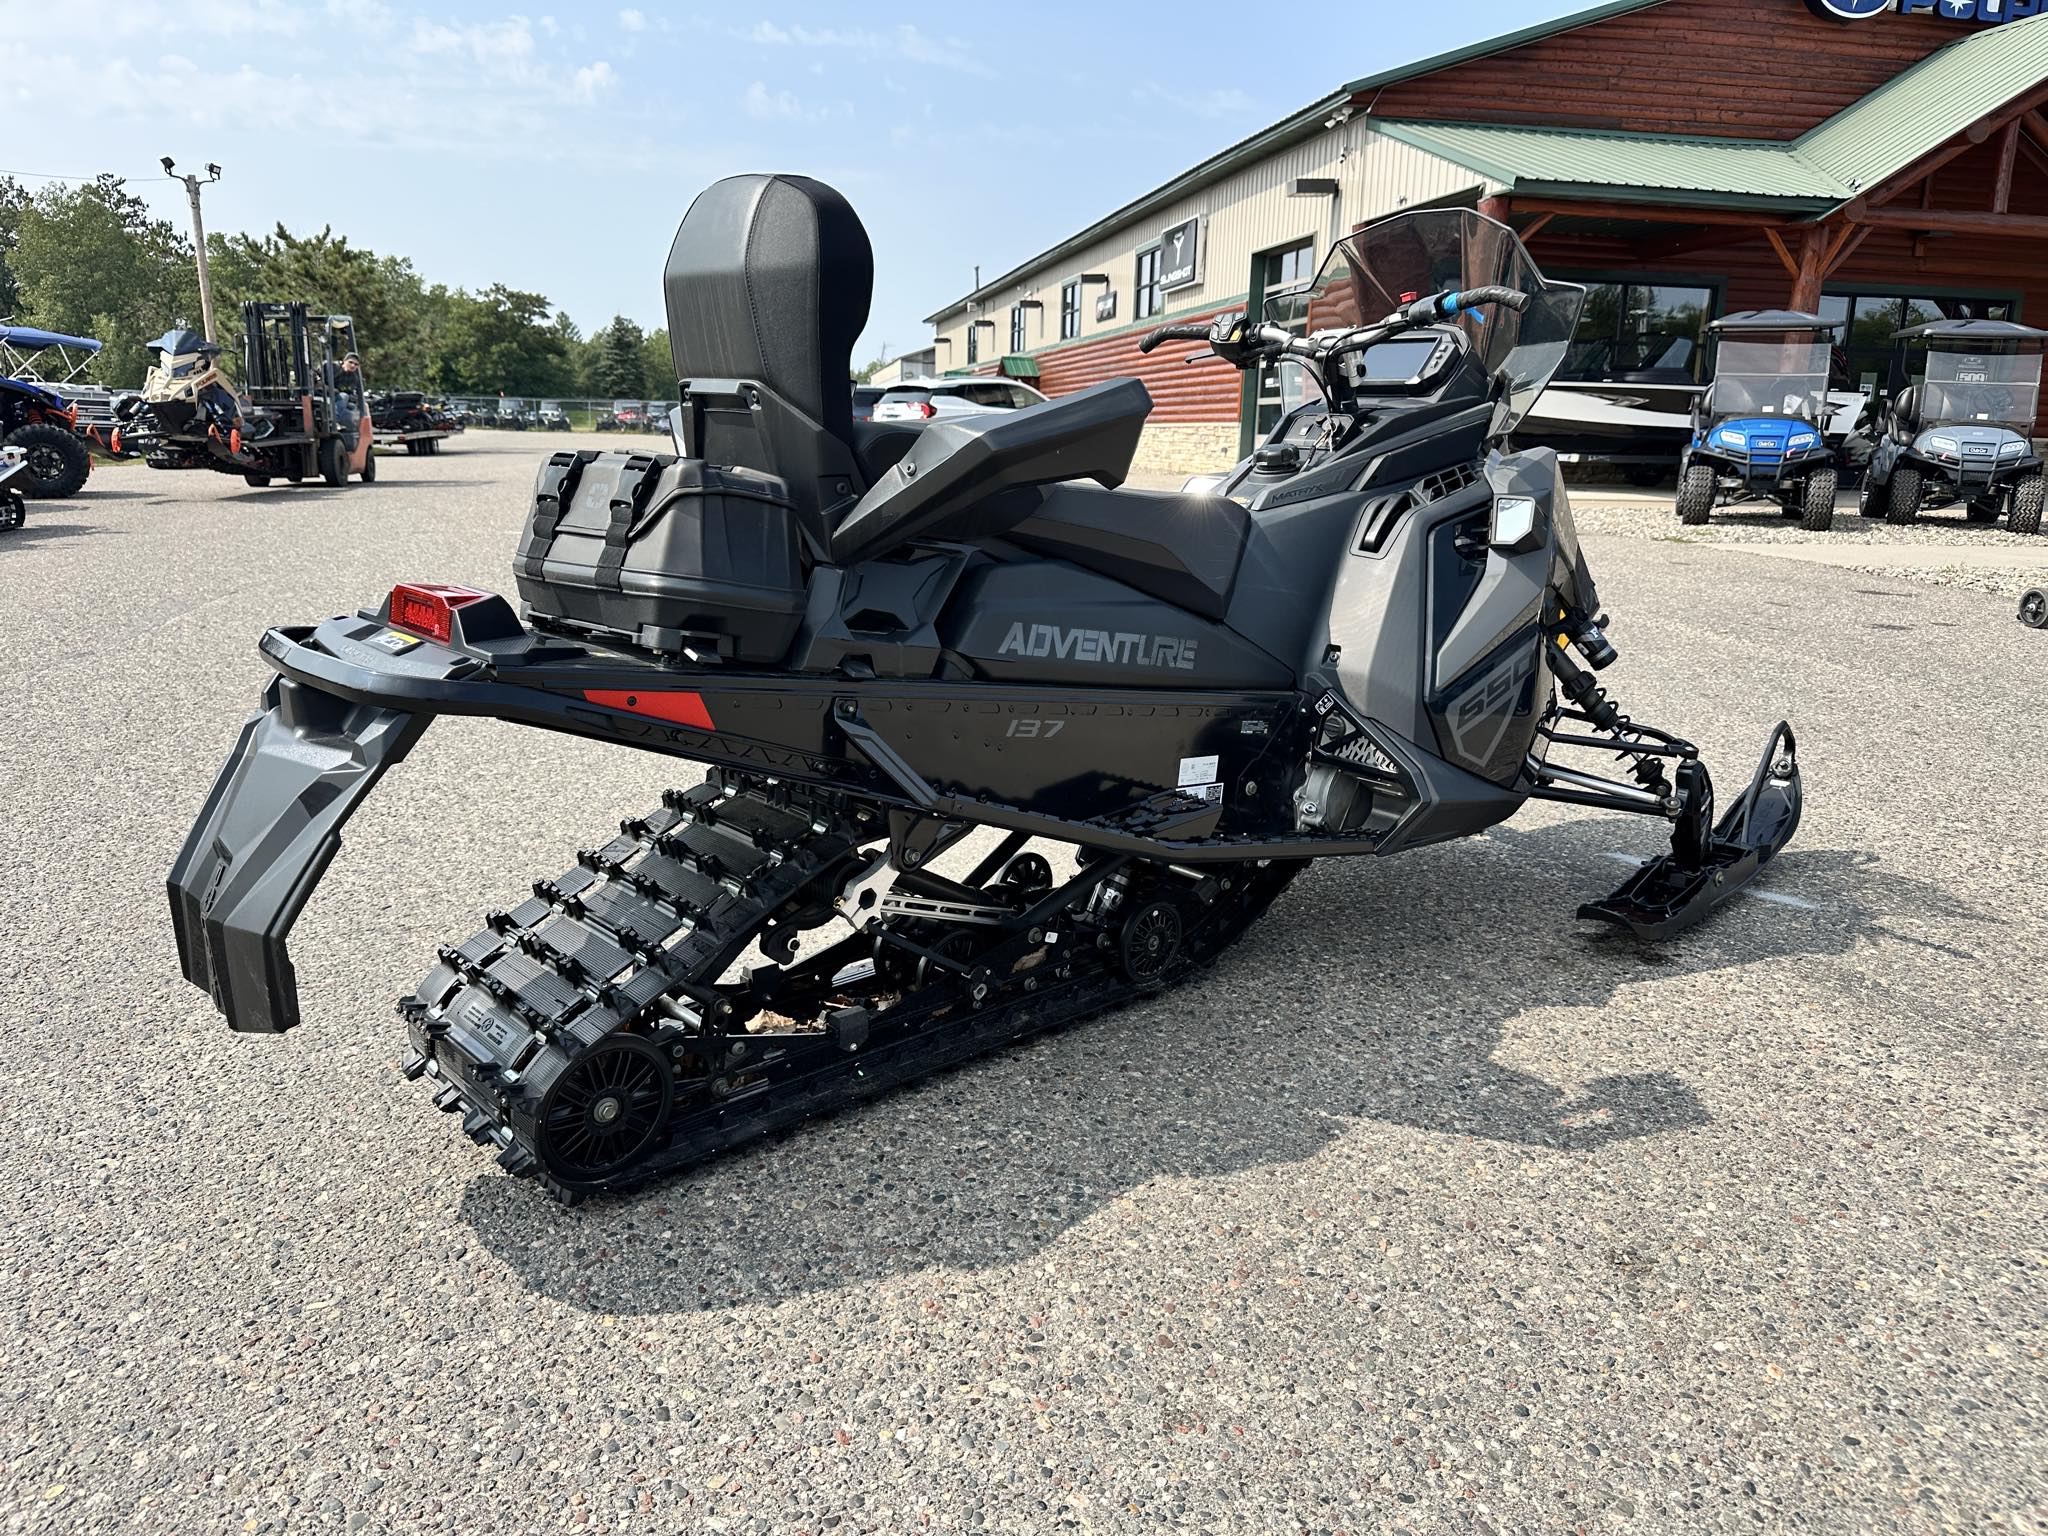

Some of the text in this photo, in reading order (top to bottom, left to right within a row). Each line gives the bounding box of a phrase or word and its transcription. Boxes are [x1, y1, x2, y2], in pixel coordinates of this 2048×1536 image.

[998, 621, 1199, 670] ADVENTURE
[1456, 647, 1536, 731] 650
[1006, 719, 1065, 738] 137
